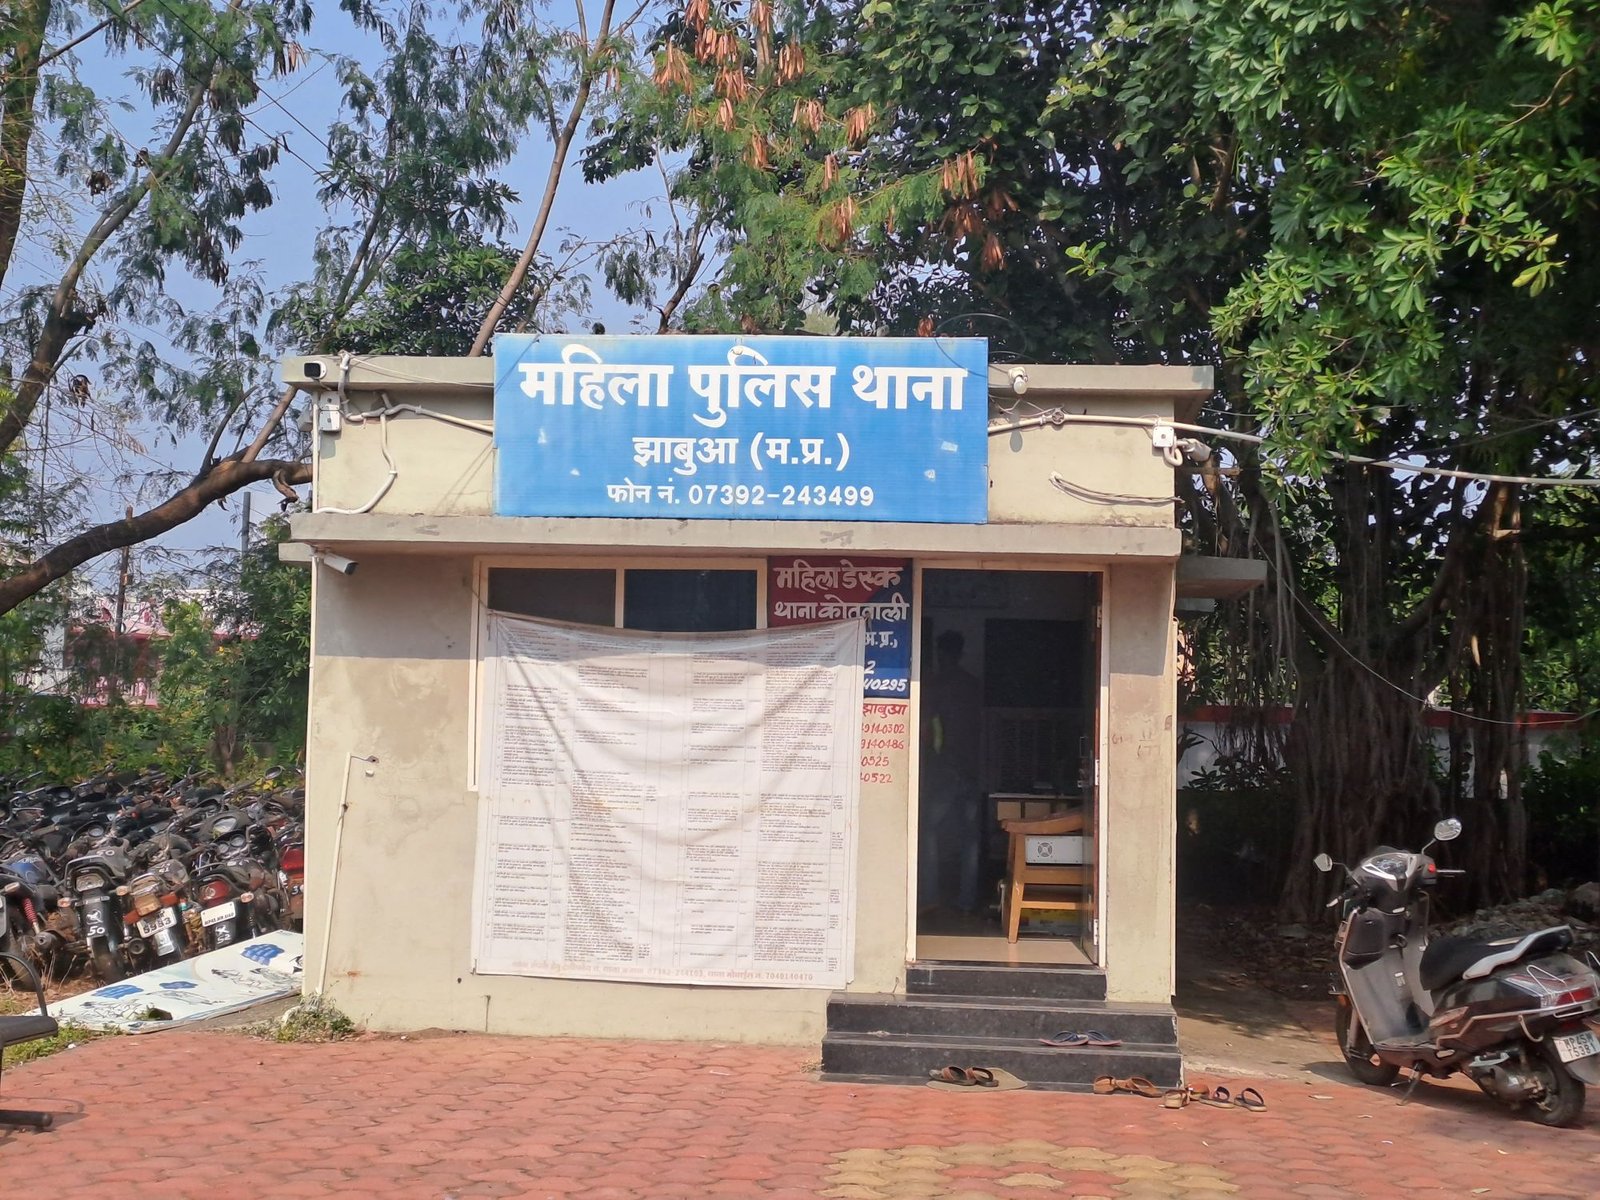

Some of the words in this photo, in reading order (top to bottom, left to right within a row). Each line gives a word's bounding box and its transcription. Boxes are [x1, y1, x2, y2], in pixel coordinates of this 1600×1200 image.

[518, 344, 673, 410] महिला
[688, 346, 836, 428] पुलिस
[852, 364, 968, 411] थाना
[632, 436, 738, 475] झाबुआ
[750, 432, 850, 471] (म.प्र.)
[606, 477, 650, 504] फोन
[657, 478, 681, 505] नं.
[688, 483, 875, 507] 07392-243499
[773, 559, 839, 594] महिला
[840, 559, 904, 591] डेस्क
[774, 601, 818, 619] थाना
[818, 592, 910, 622] कोतवाली
[863, 703, 908, 719] झाबुआ
[87, 925, 106, 937] 50
